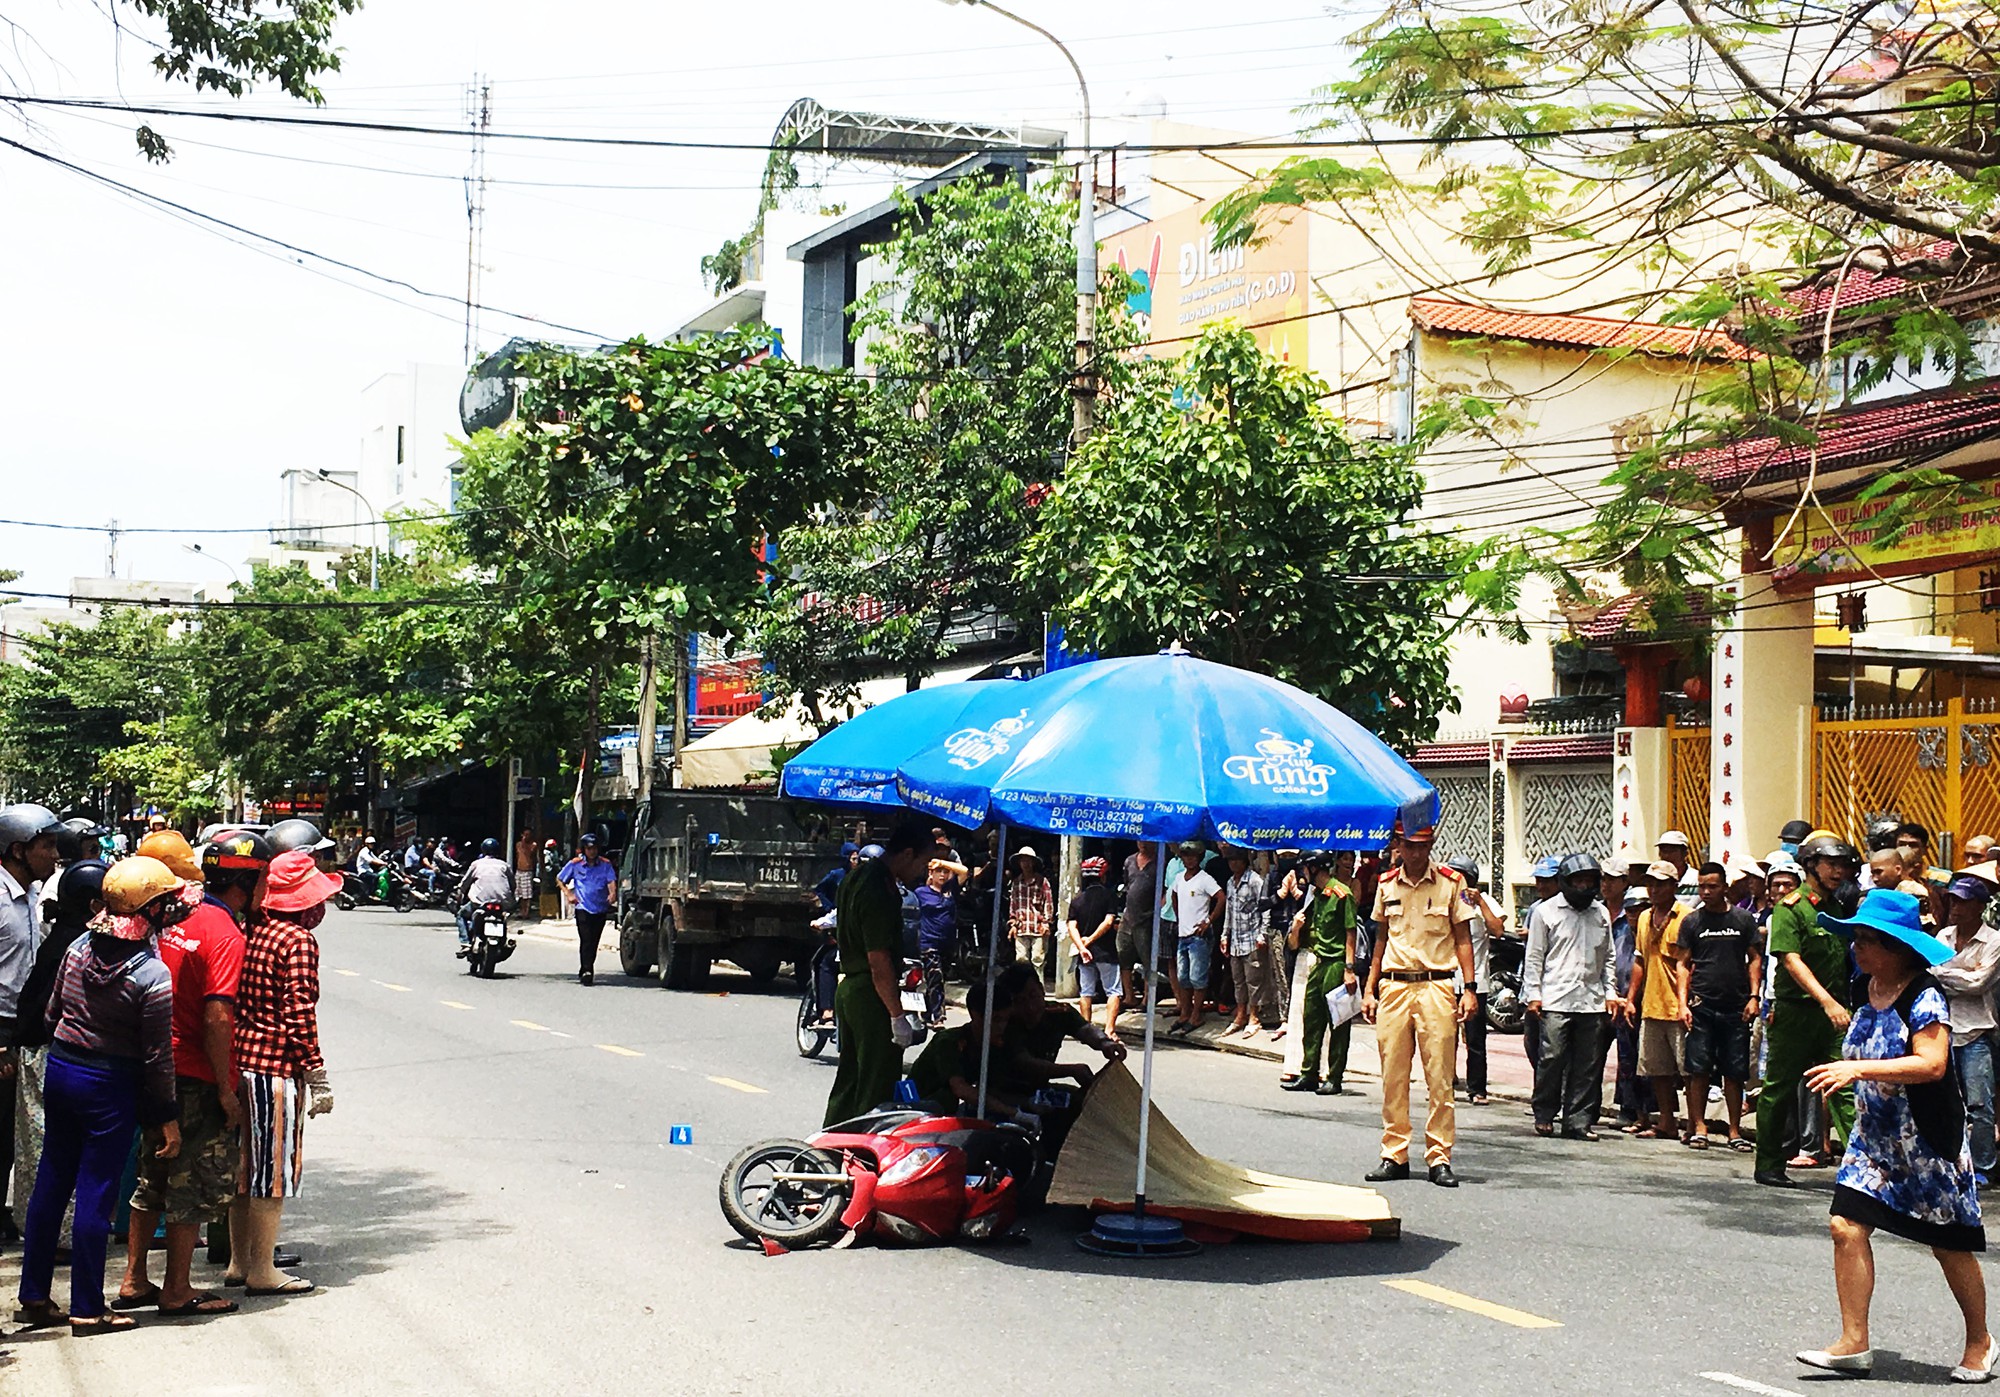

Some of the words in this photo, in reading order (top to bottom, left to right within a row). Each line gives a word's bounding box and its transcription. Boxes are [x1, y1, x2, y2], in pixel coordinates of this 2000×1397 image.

[1245, 271, 1296, 309] (C.O.D)
[1001, 791, 1018, 801] 123
[1020, 792, 1056, 804] Nguyễn
[1085, 796, 1098, 806] P5
[1176, 804, 1195, 815] Yên
[1072, 808, 1144, 823] (057)3.823799
[1217, 821, 1248, 839] Hòa
[1252, 824, 1294, 843] quyện
[1298, 824, 1331, 843] cùng
[1335, 823, 1363, 840] cảm
[1367, 824, 1391, 840] xúc
[758, 867, 799, 882] 148.14
[904, 1083, 914, 1099] 1
[678, 1127, 687, 1142] 4
